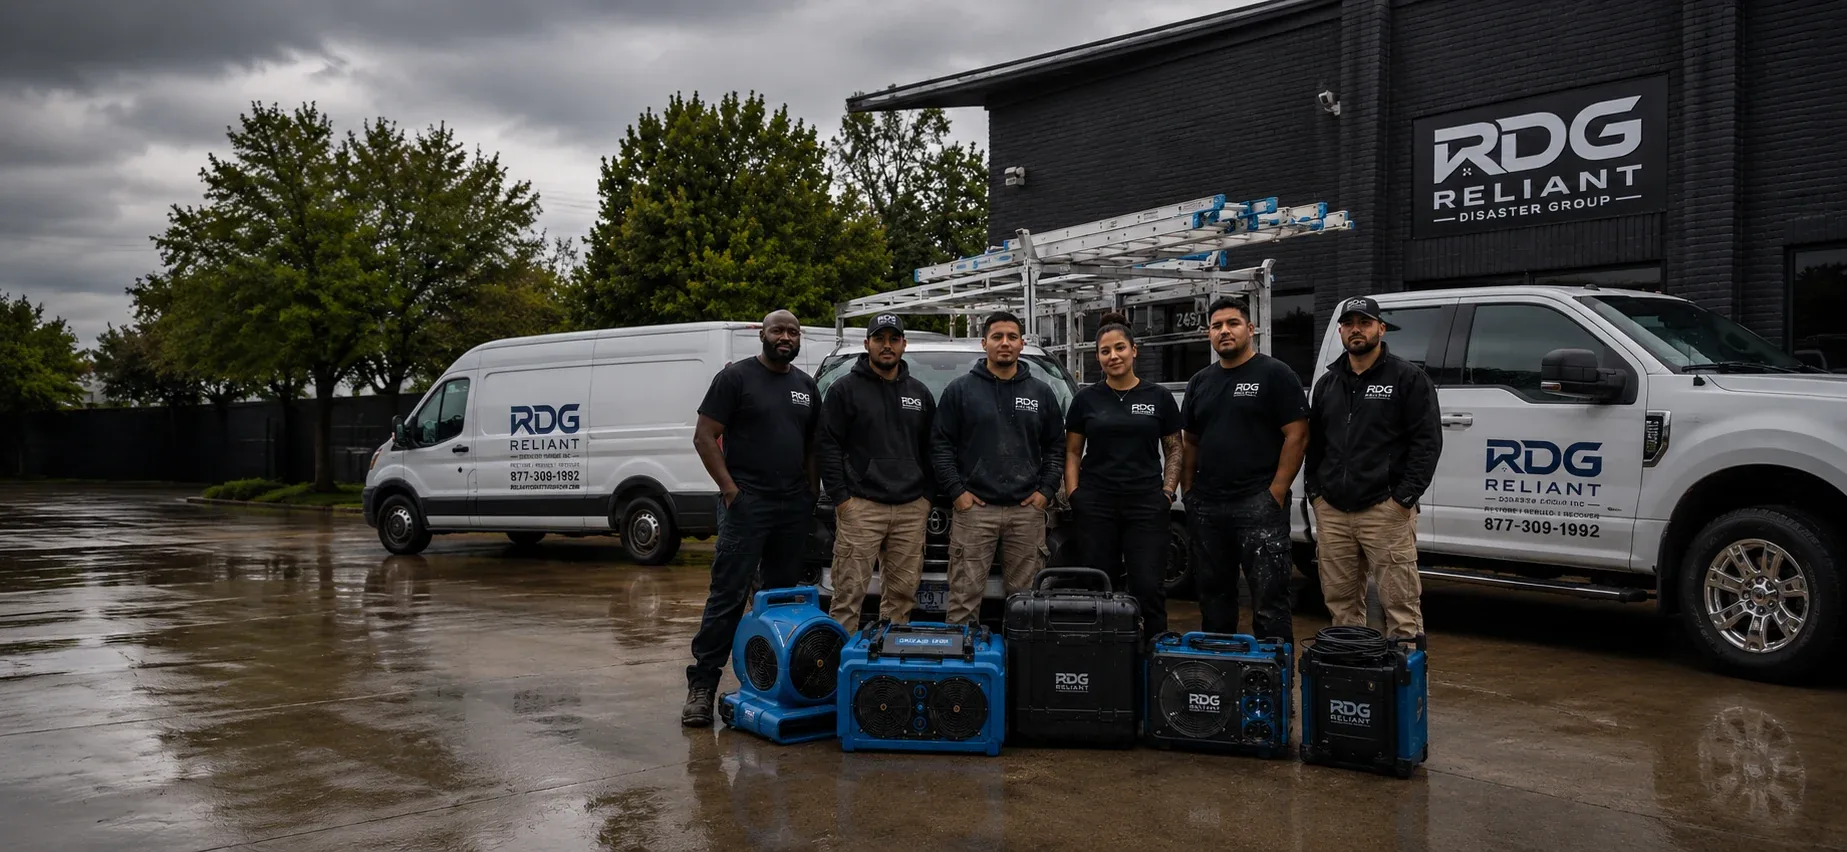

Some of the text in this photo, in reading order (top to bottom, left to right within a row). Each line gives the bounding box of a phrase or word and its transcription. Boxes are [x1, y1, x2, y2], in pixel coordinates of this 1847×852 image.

[1433, 95, 1643, 184] RDG
[1433, 164, 1643, 210] RELIANT
[1459, 195, 1611, 222] DISASTER GROUP
[1235, 383, 1260, 391] RDG
[1366, 385, 1394, 394] RDG
[1015, 397, 1039, 408] RDG
[1131, 404, 1155, 412] RDG
[510, 403, 580, 436] RDG
[510, 438, 580, 451] RELIANT
[1485, 439, 1603, 478] RDG
[1485, 478, 1601, 497] RELIANT
[1484, 517, 1600, 538] 877-309-1992
[1055, 672, 1089, 685] RDG
[1189, 693, 1220, 706] RDG
[1330, 699, 1371, 718] RDG
